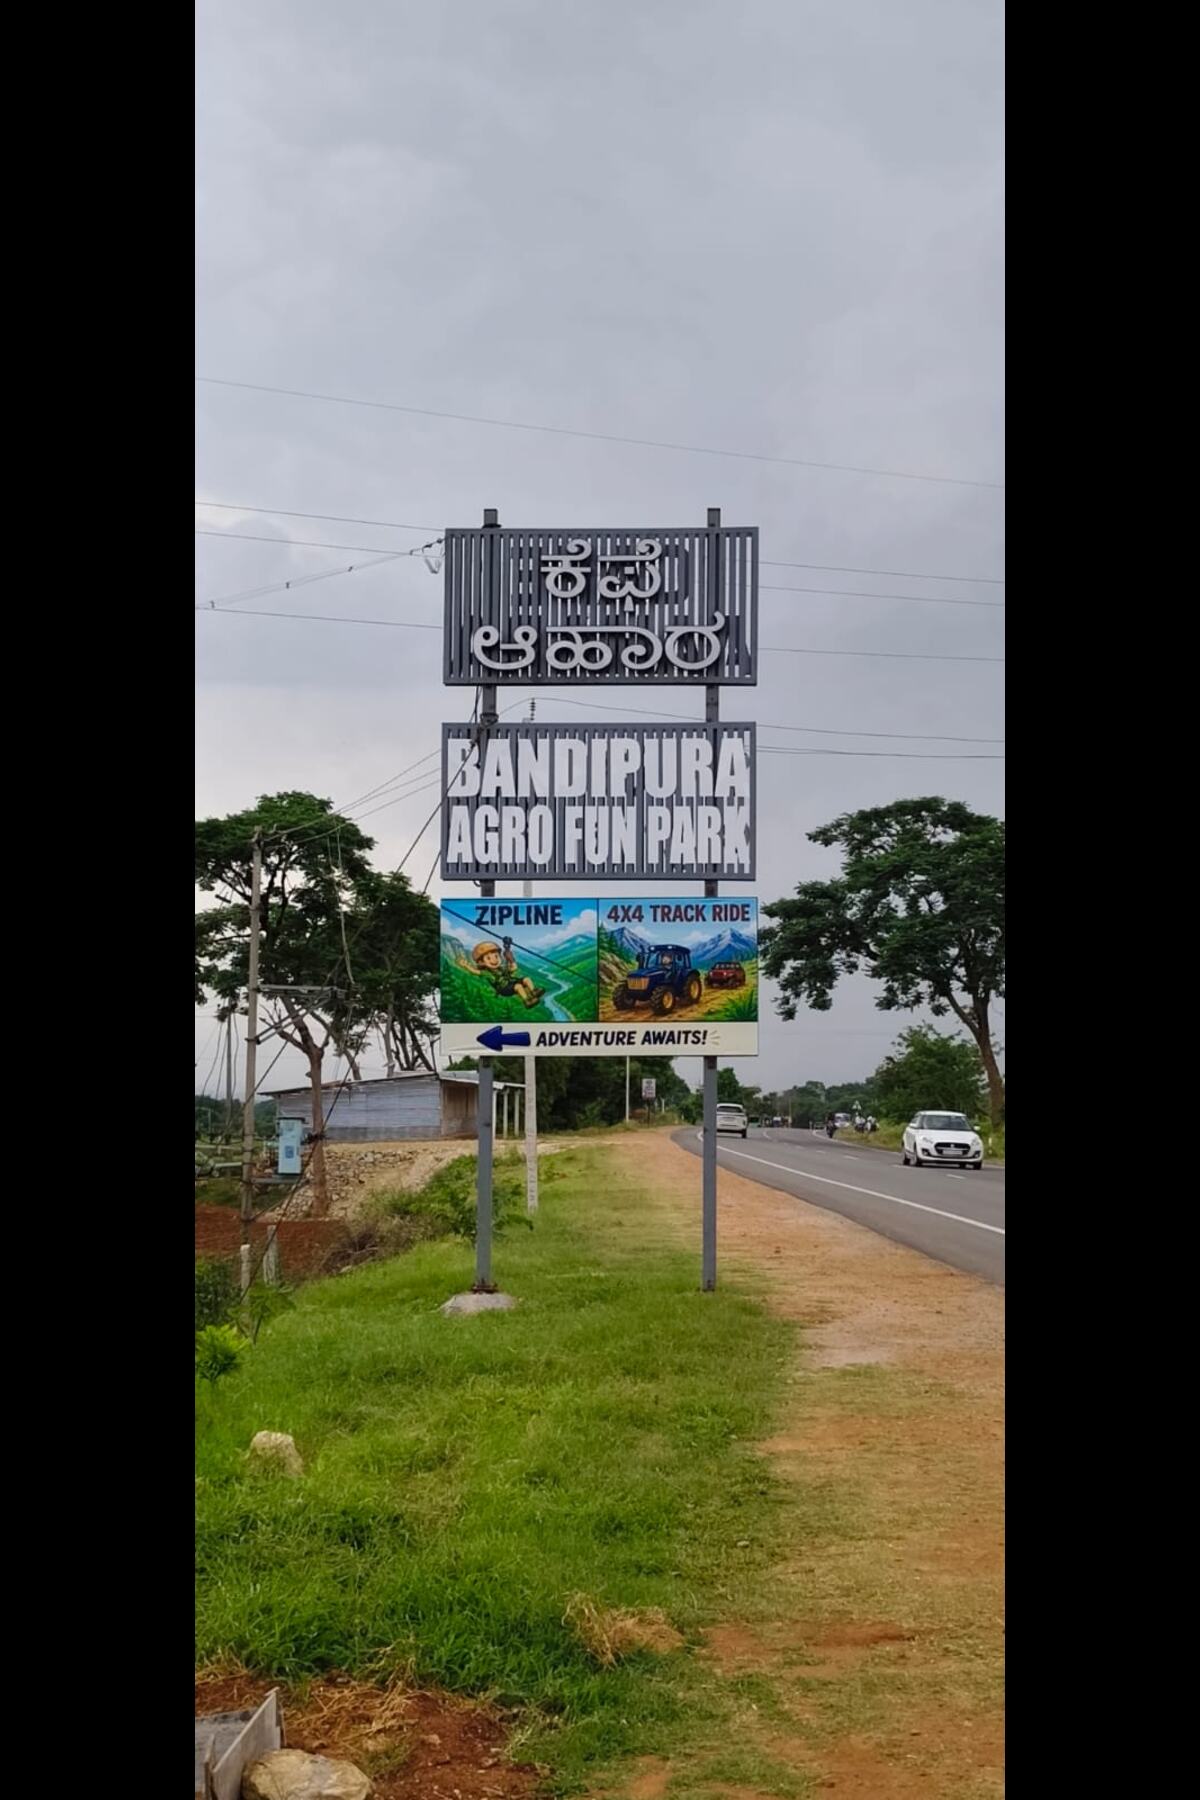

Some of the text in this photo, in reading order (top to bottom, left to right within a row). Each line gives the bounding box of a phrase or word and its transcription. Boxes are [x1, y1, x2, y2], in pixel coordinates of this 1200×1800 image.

[447, 738, 750, 798] BANDIPURA
[447, 804, 750, 865] AGRO FUN PARK
[475, 905, 563, 926] ZIPLINE
[607, 904, 751, 923] 4X4 TRACK RIDE
[536, 1030, 708, 1047] ADVENTURE AWAITS!
